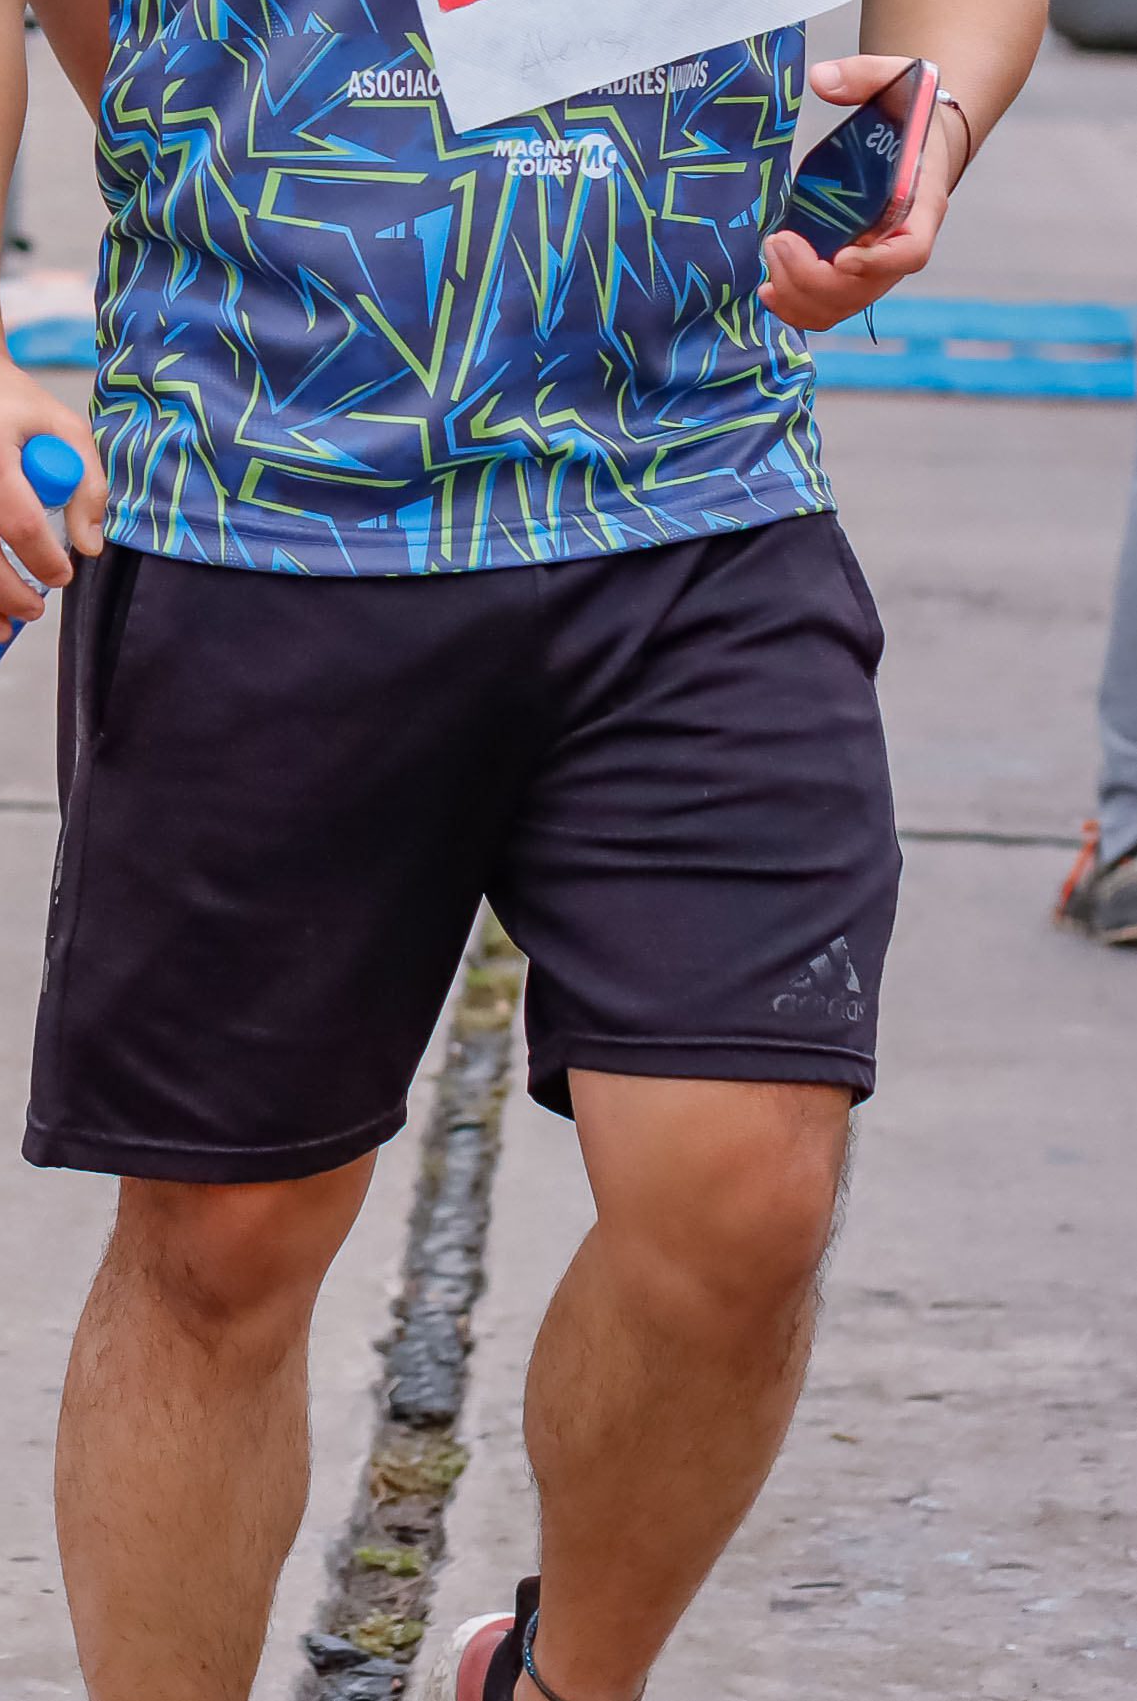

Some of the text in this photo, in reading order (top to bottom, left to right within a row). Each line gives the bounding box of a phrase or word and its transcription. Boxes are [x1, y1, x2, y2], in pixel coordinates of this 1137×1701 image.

[670, 60, 709, 93] UNIDOS
[493, 139, 575, 157] MAGNY
[507, 157, 572, 176] COURS
